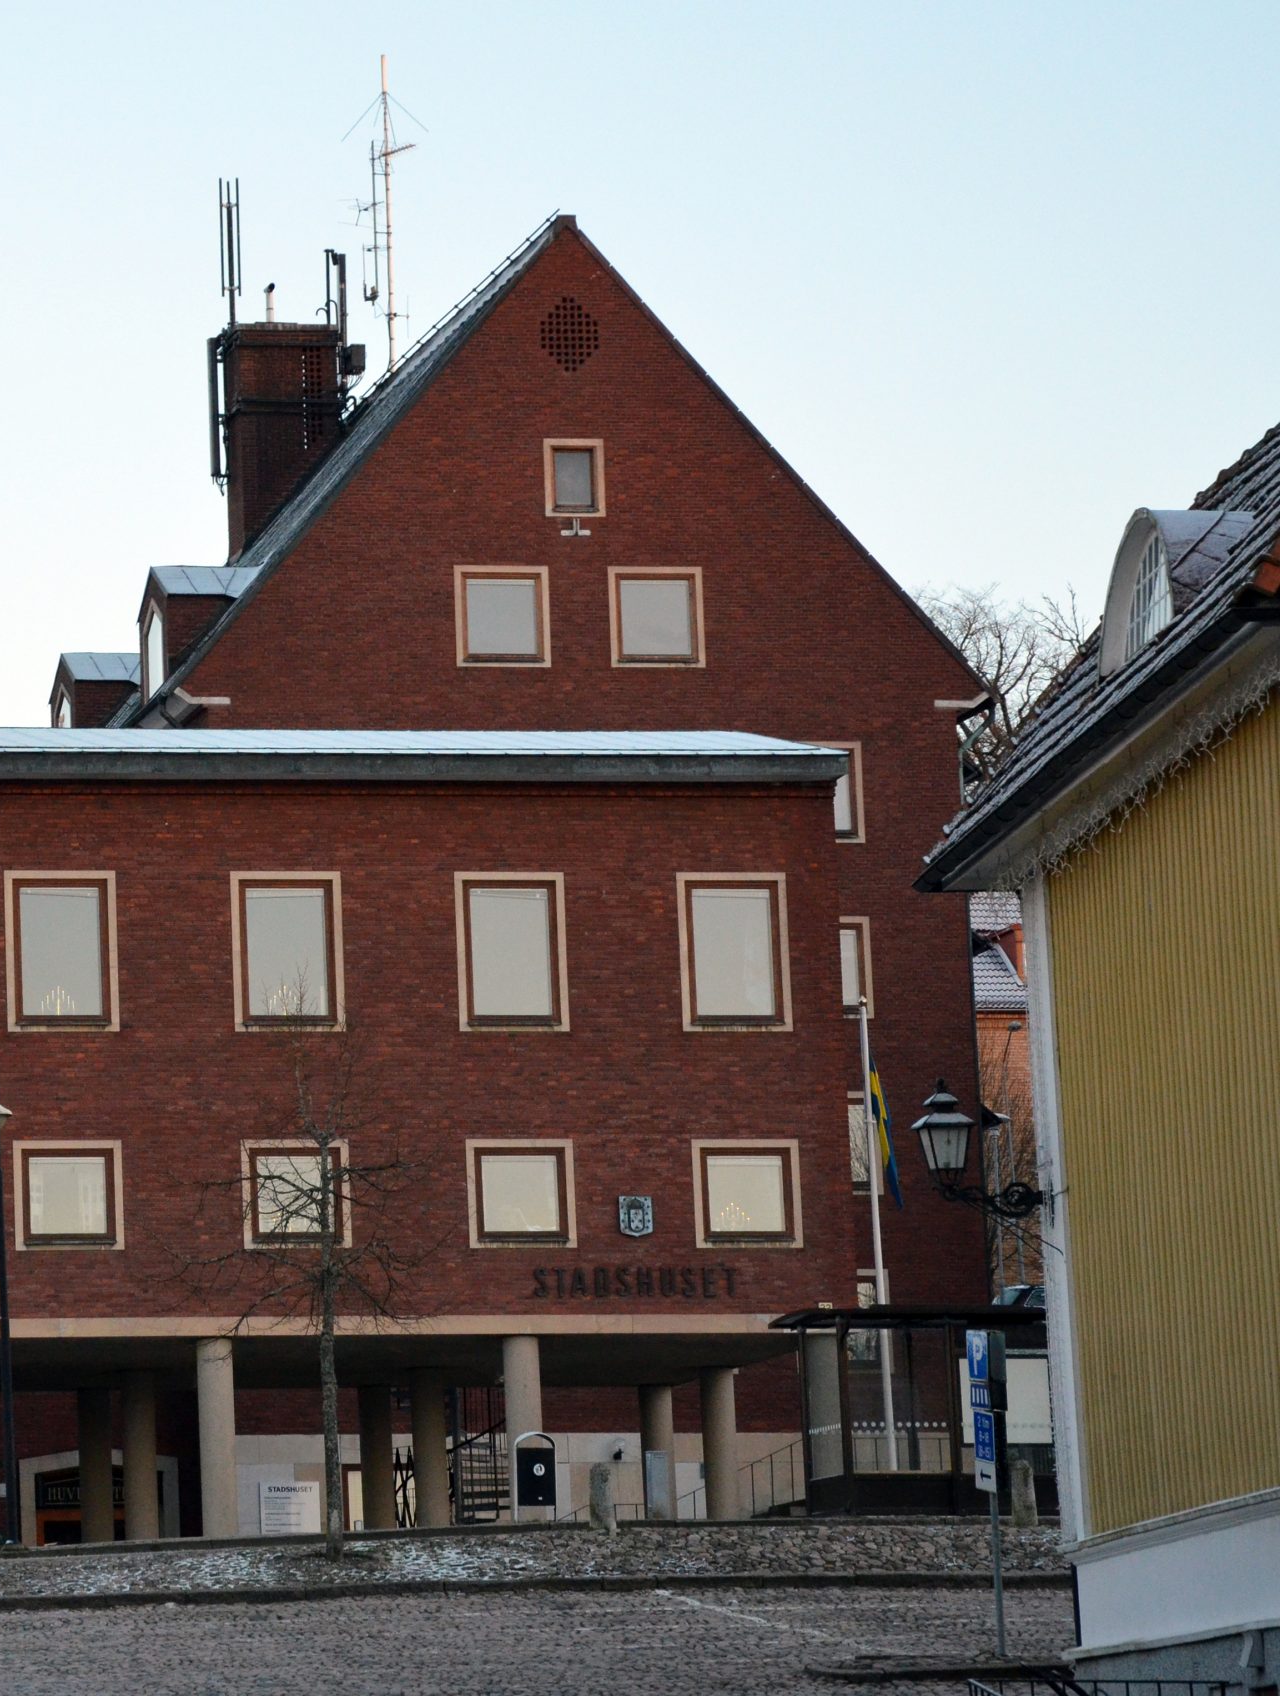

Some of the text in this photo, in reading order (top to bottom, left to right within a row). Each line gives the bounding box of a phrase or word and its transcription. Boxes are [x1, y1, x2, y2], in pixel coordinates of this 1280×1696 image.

[533, 1263, 737, 1298] STADSHUSET
[973, 1336, 983, 1376] P
[267, 1485, 313, 1494] STADSHUSET
